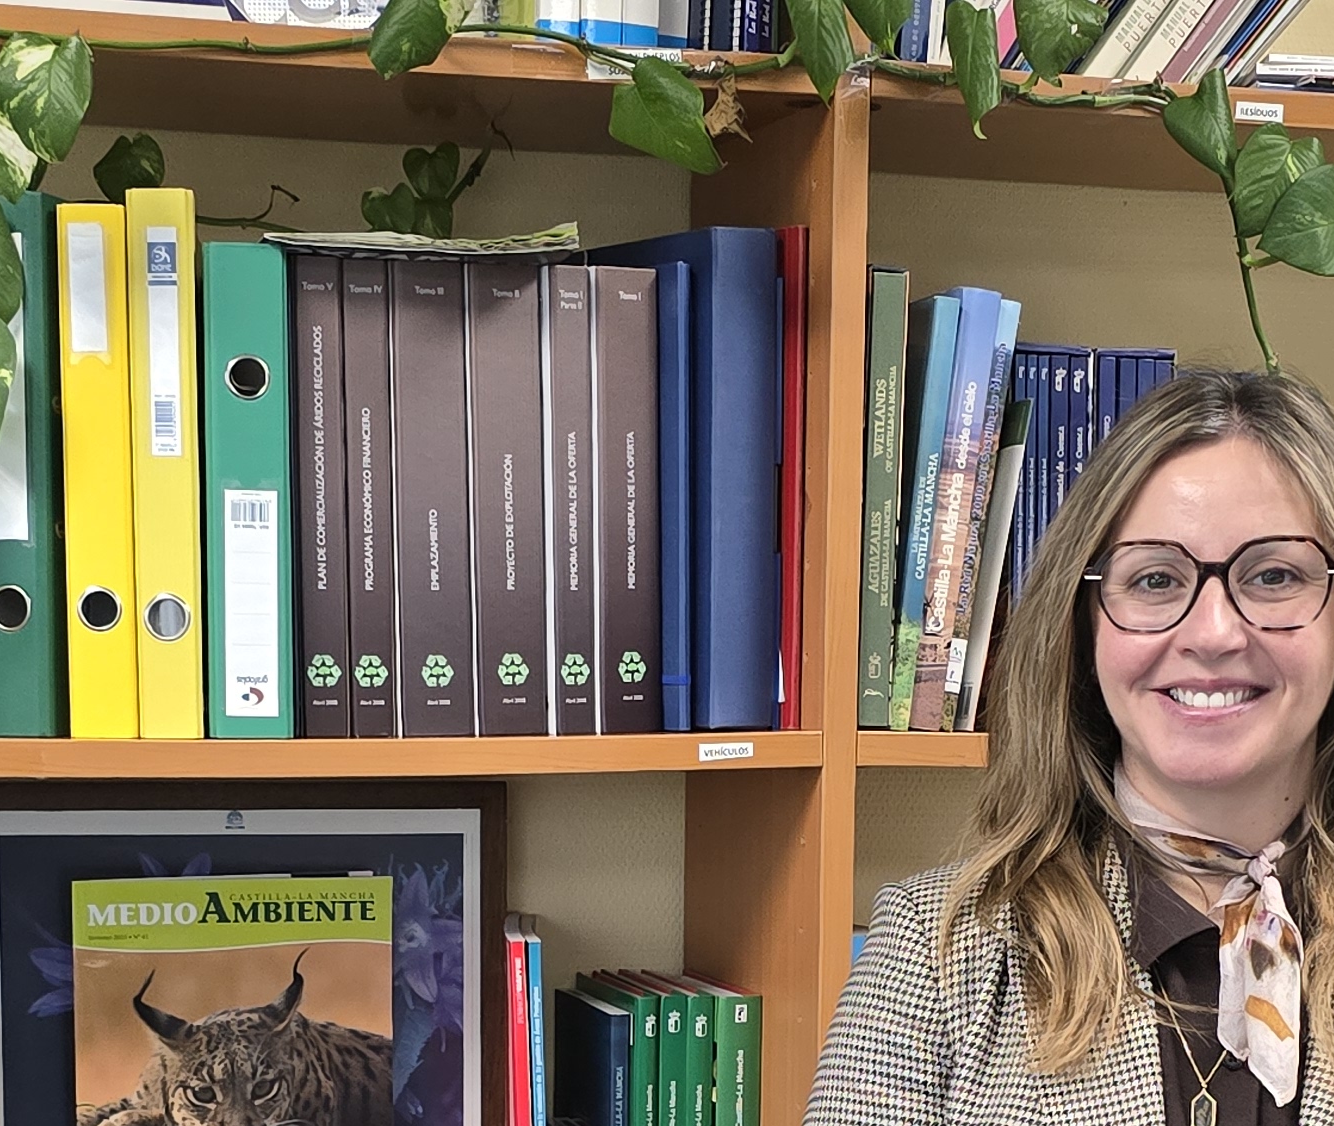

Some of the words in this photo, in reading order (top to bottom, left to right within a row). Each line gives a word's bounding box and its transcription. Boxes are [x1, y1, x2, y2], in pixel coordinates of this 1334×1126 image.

[872, 377, 887, 458] WETLANDS
[959, 412, 974, 427] el
[961, 380, 978, 413] cielo
[361, 406, 371, 468] FINANCIERO
[954, 427, 972, 470] desde
[361, 469, 374, 534] ECONÓMICO
[923, 451, 940, 505] MANCHA
[938, 471, 965, 538] Mancha
[363, 534, 374, 591] PROGRAMA
[428, 507, 439, 591] EMPLAZAMIENTO
[867, 509, 883, 593] AGUAZALES
[914, 505, 933, 580] CASTILLA-LA
[925, 539, 956, 632] Castilla-La
[704, 746, 749, 758] VEHÍCULOS
[87, 901, 198, 927] MEDIO
[198, 891, 376, 923] AMBIENTE
[320, 891, 376, 900] MANCHA
